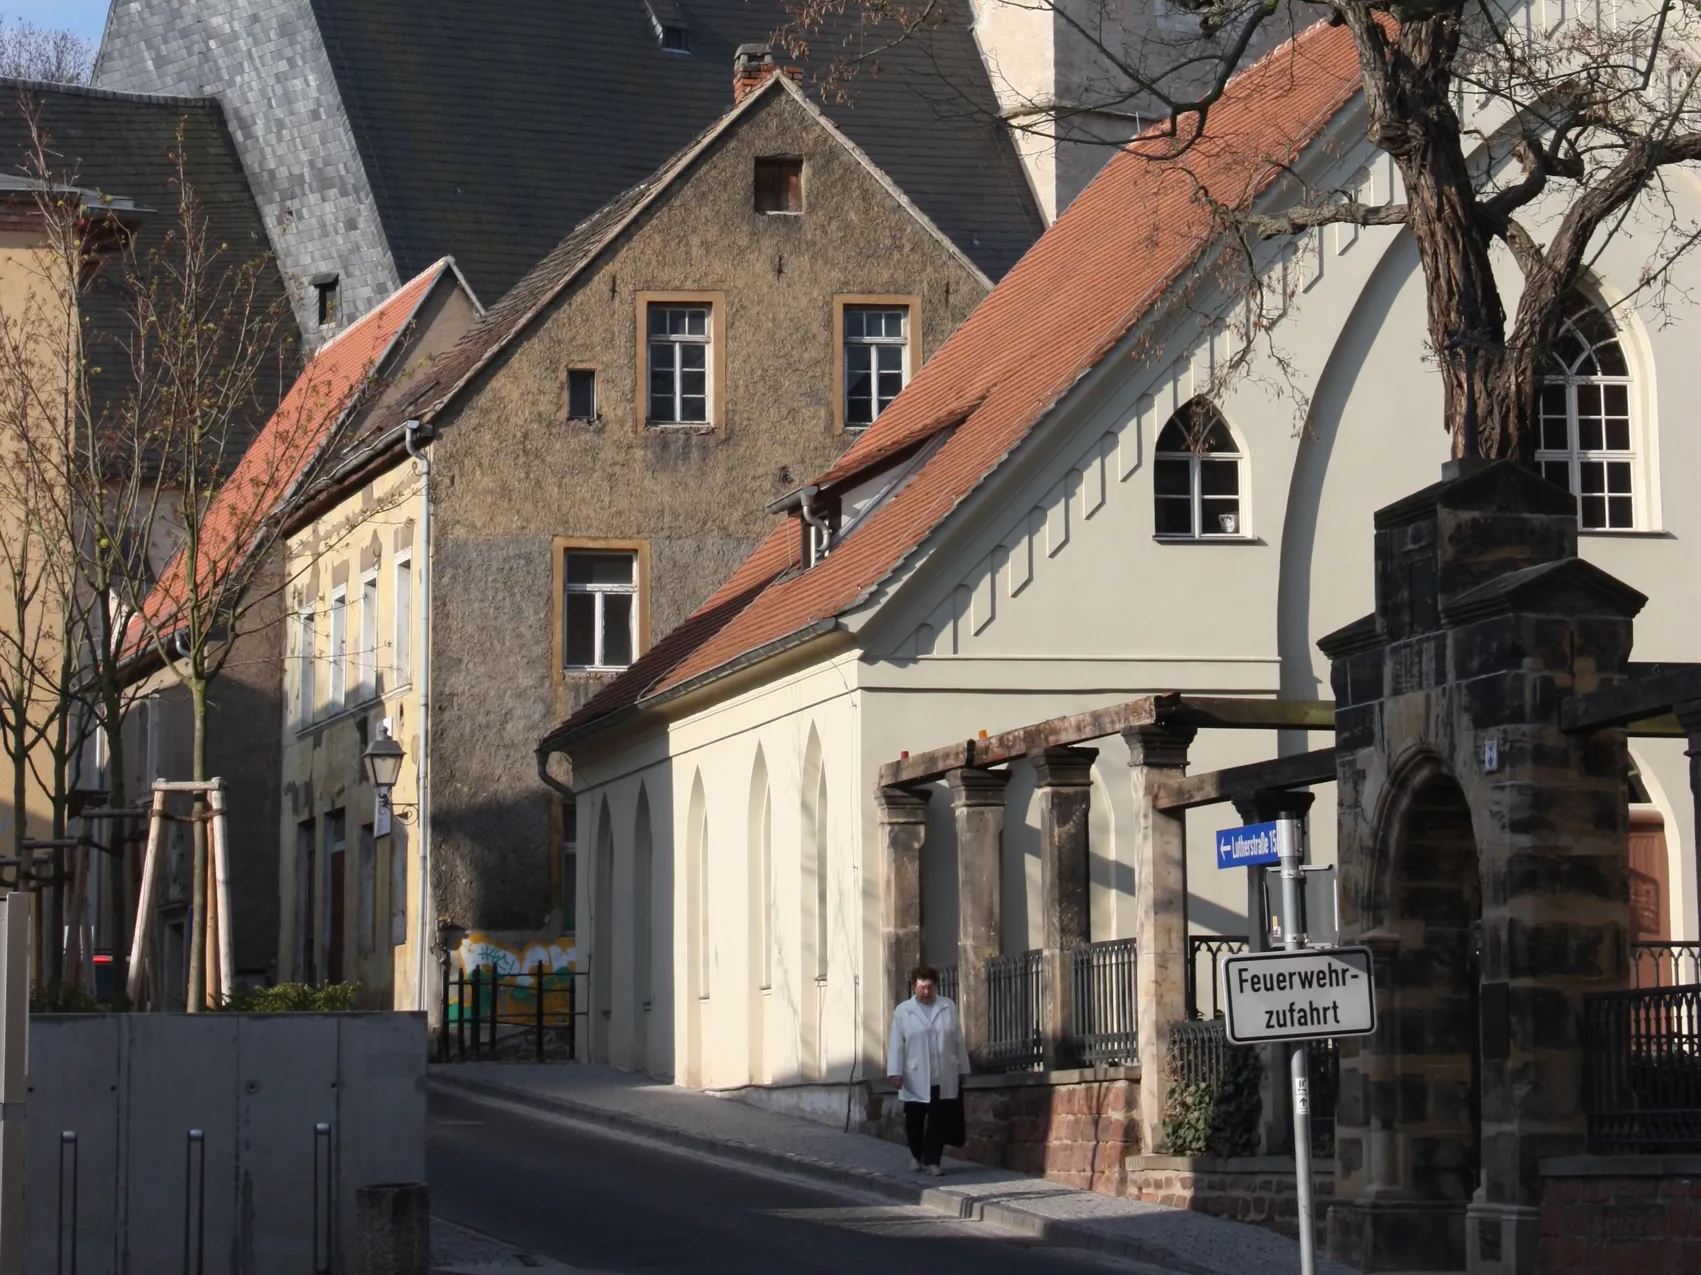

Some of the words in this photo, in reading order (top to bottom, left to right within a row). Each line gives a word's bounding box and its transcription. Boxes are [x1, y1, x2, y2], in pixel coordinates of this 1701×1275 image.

[1231, 831, 1269, 859] Lutherstraße
[1238, 962, 1359, 993] Feuerwehr-
[1264, 1000, 1340, 1029] zufahrt
